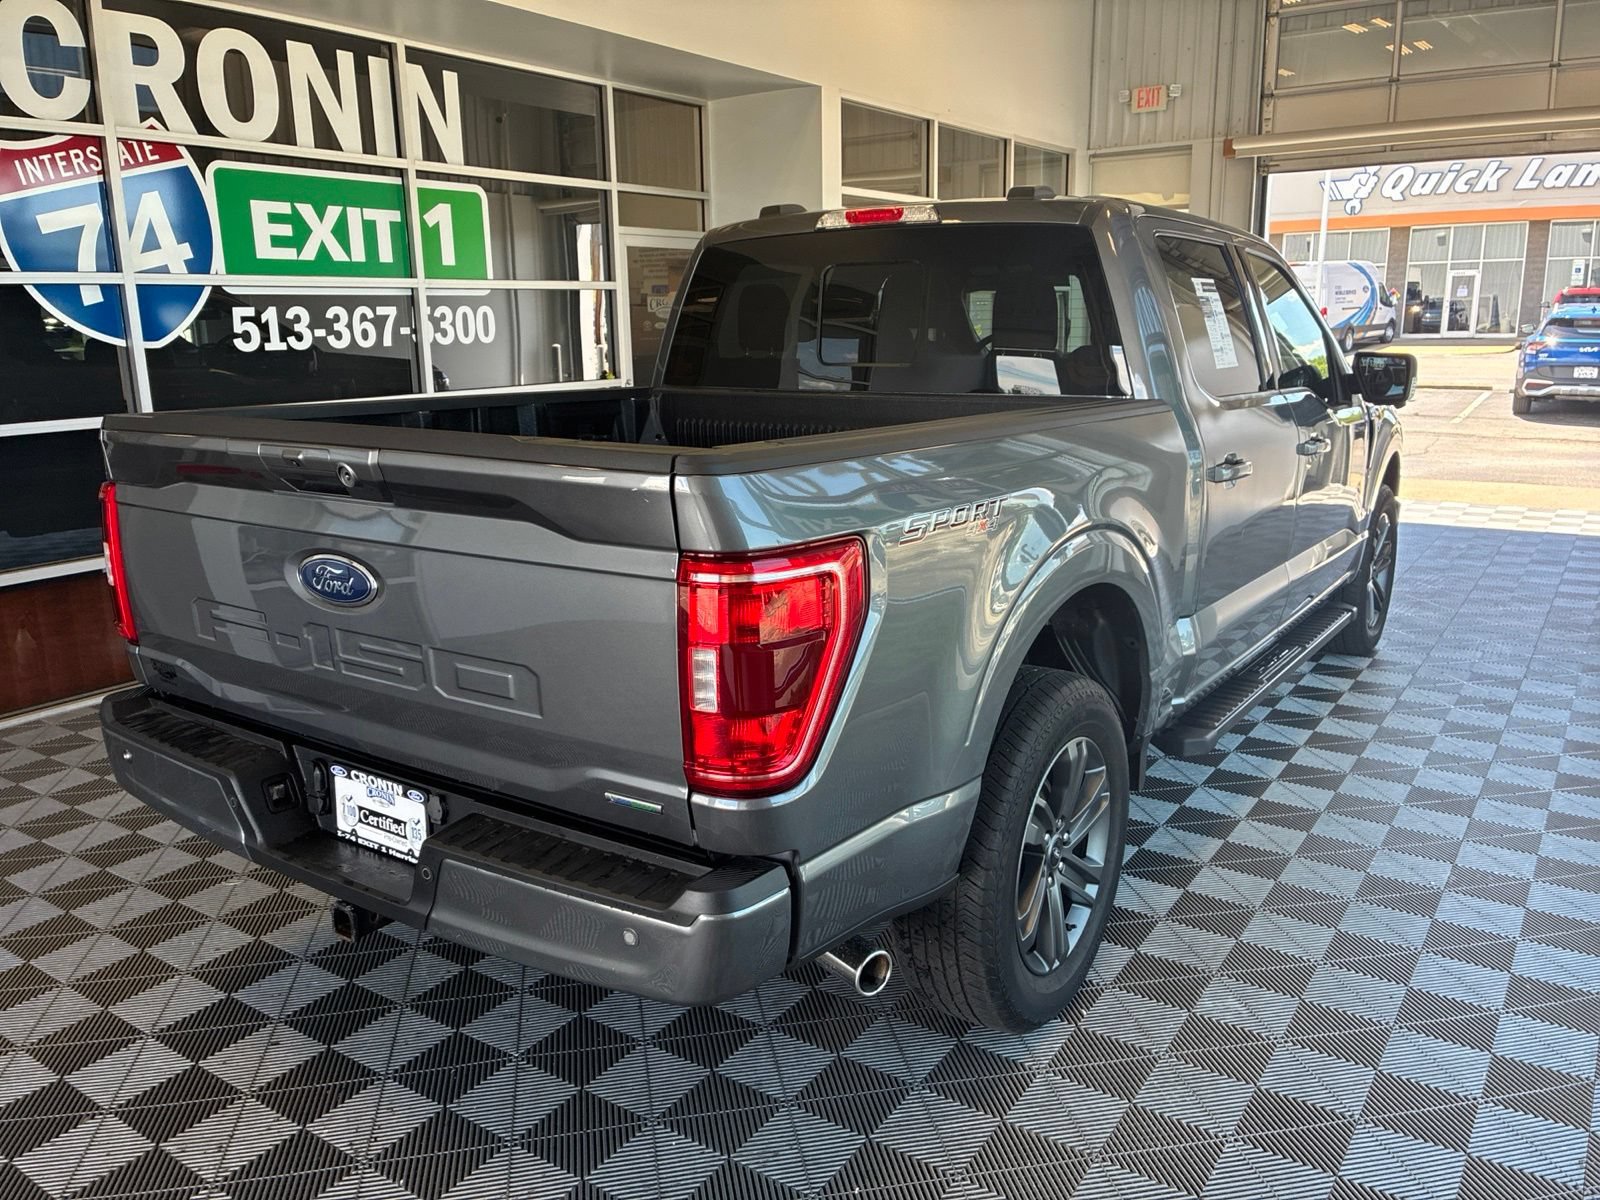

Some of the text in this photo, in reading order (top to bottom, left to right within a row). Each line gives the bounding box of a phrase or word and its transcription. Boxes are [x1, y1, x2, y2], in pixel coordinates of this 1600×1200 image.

[0, 0, 464, 165] CRONIN
[1136, 84, 1162, 109] EXIT
[14, 139, 160, 186] INTERSATE
[1381, 160, 1513, 201] Quick
[35, 191, 194, 306] 74
[249, 199, 456, 267] EXIT 1
[898, 496, 1010, 547] SPORT
[312, 564, 354, 596] Ford
[191, 597, 543, 719] F-150
[350, 770, 403, 796] CRONIN
[360, 809, 406, 836] Certified
